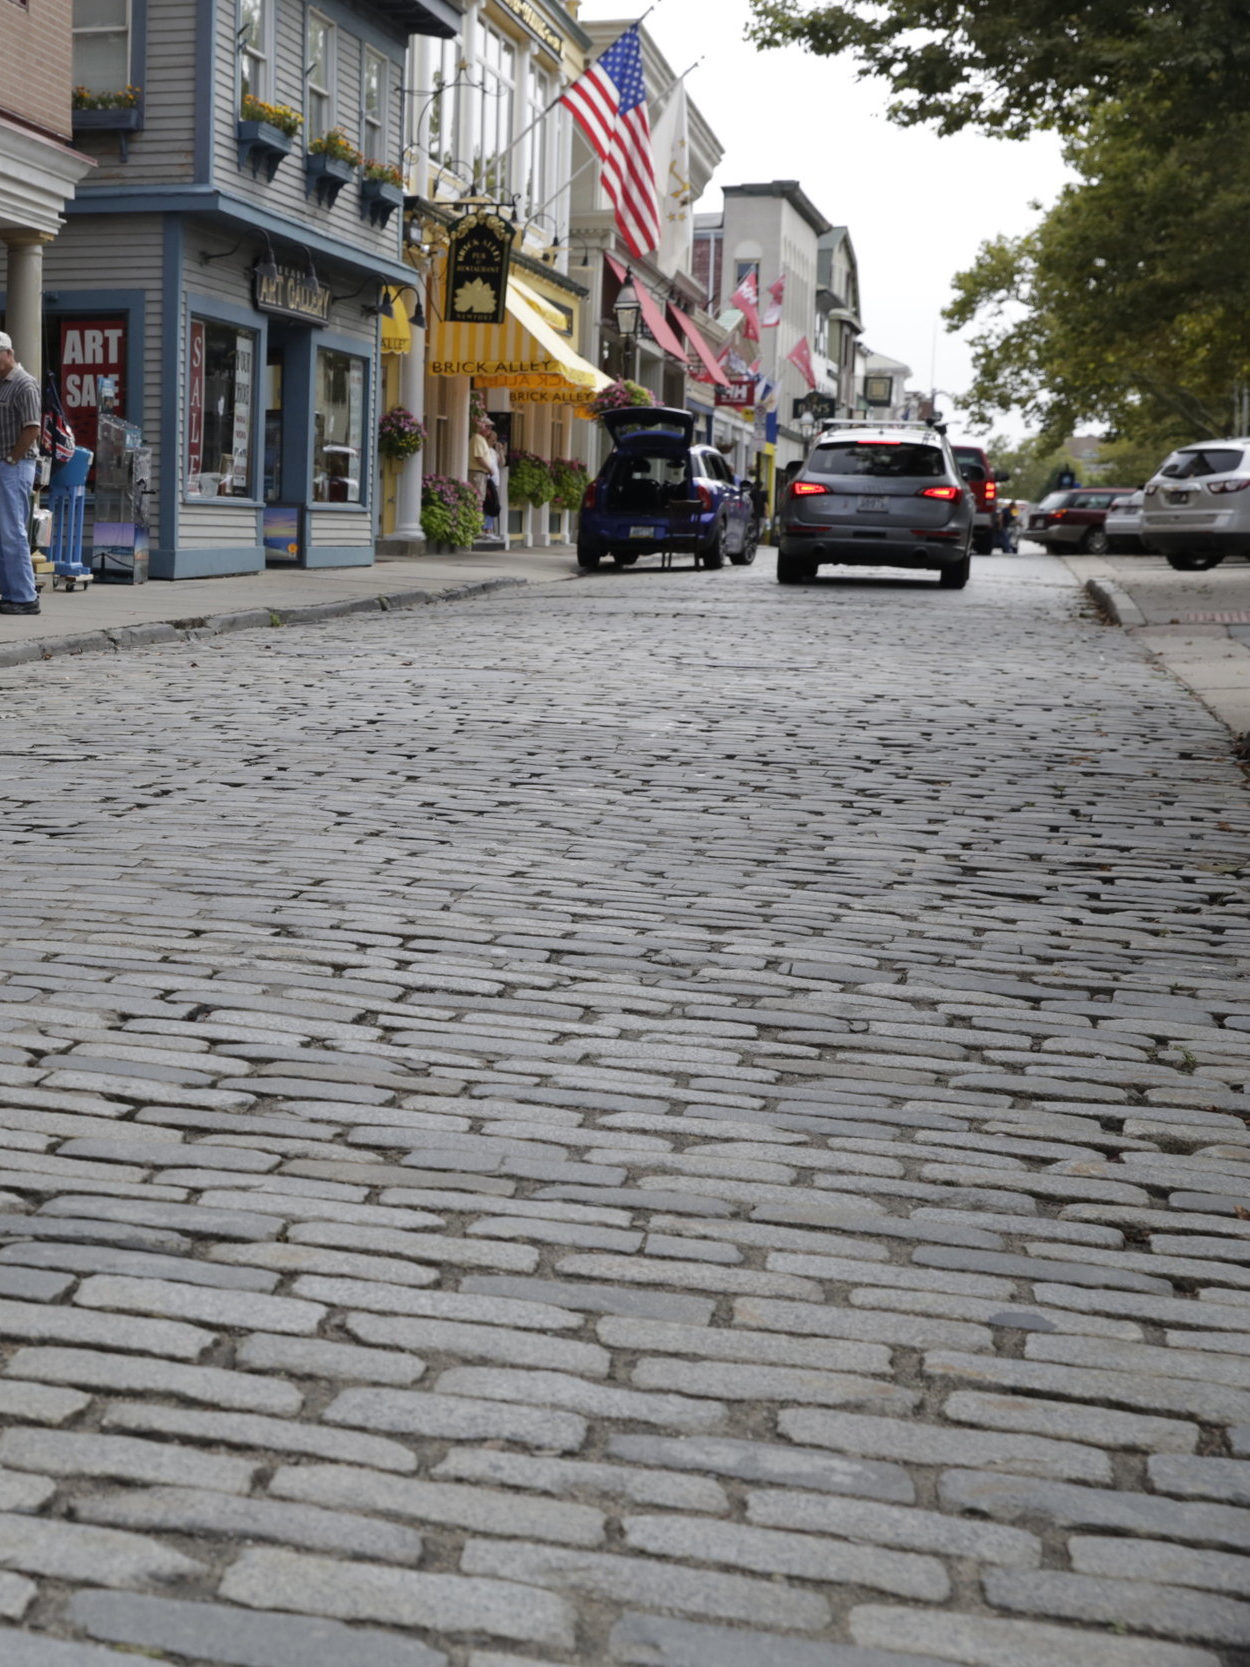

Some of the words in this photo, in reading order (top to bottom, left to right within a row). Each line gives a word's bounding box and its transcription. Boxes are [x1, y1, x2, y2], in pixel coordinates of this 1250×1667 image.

[63, 329, 123, 364] ART
[432, 361, 488, 374] BRICK
[494, 361, 551, 373] ALLEY
[66, 374, 119, 408] SAE
[510, 392, 548, 402] BRICK
[553, 392, 592, 402] ALLEY
[189, 337, 201, 486] SALE
